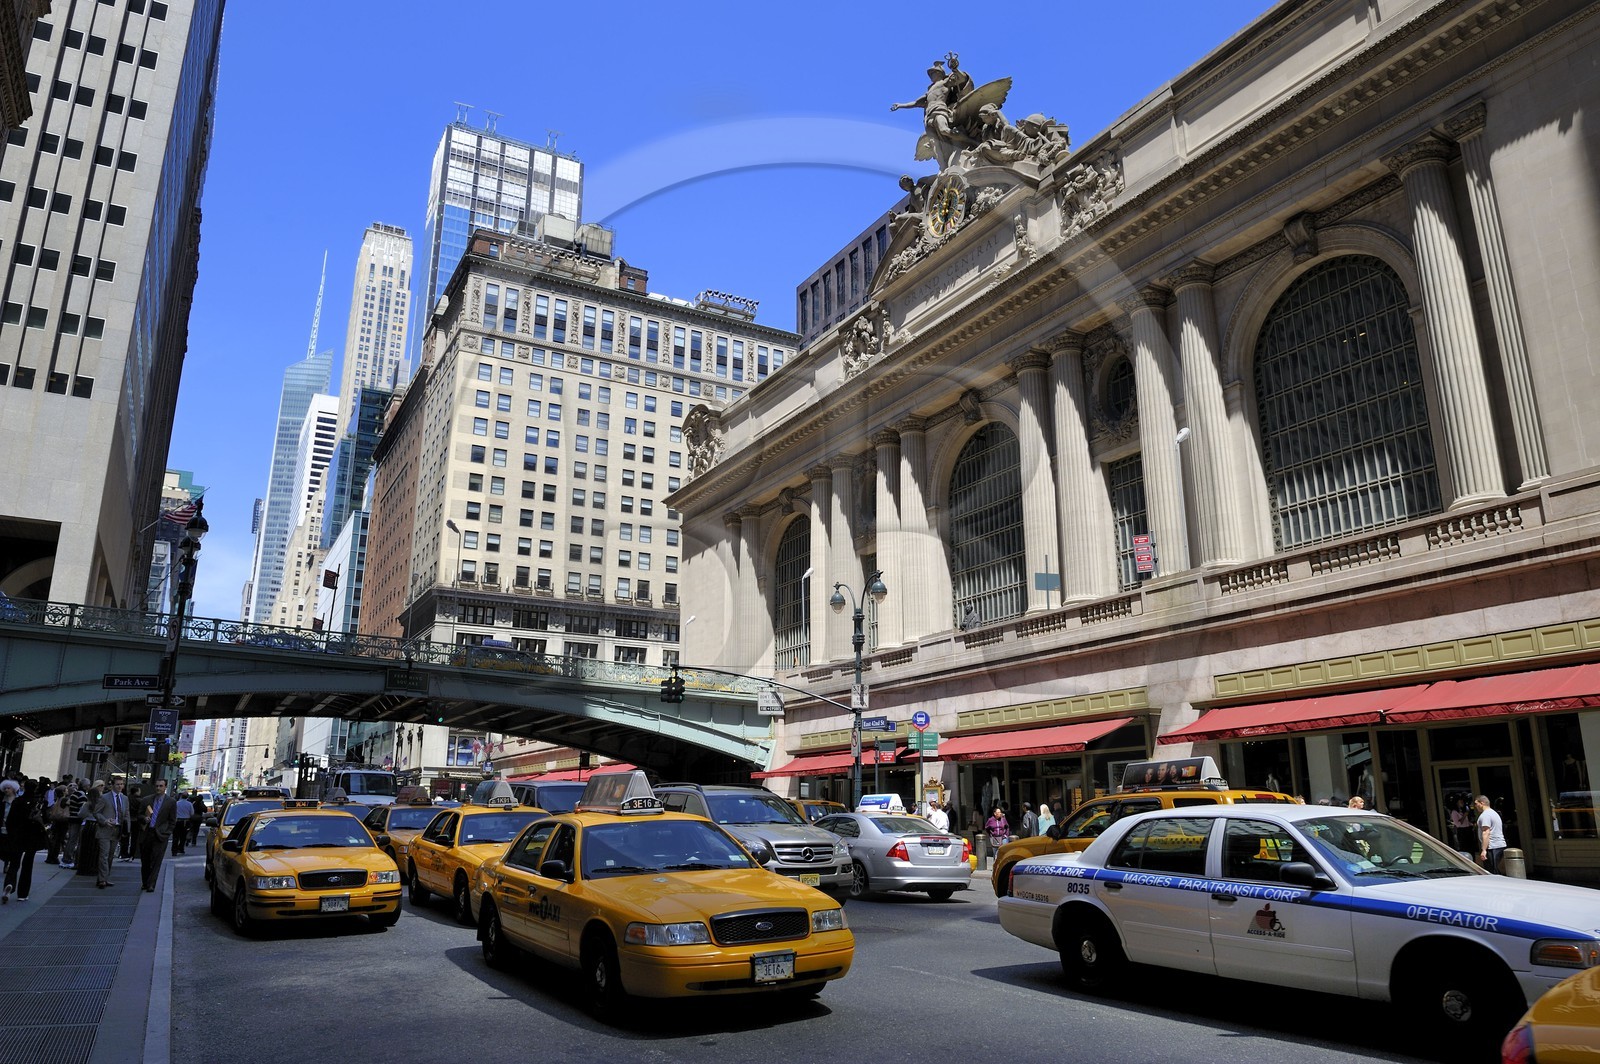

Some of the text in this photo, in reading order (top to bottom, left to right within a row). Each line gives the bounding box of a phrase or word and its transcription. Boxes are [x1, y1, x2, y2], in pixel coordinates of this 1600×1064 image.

[904, 235, 998, 307] GRAND CENTRAL
[113, 678, 150, 686] Park Ave
[632, 799, 652, 809] 3E16
[1023, 865, 1087, 878] ACCESS-A-RIDE
[1067, 882, 1090, 894] 8035
[1122, 873, 1172, 888] MAGGIES
[1178, 879, 1264, 898] PARATRANSIT
[1406, 905, 1499, 932] OPERATOR
[1246, 929, 1286, 939] ACCESS-A-RIDE
